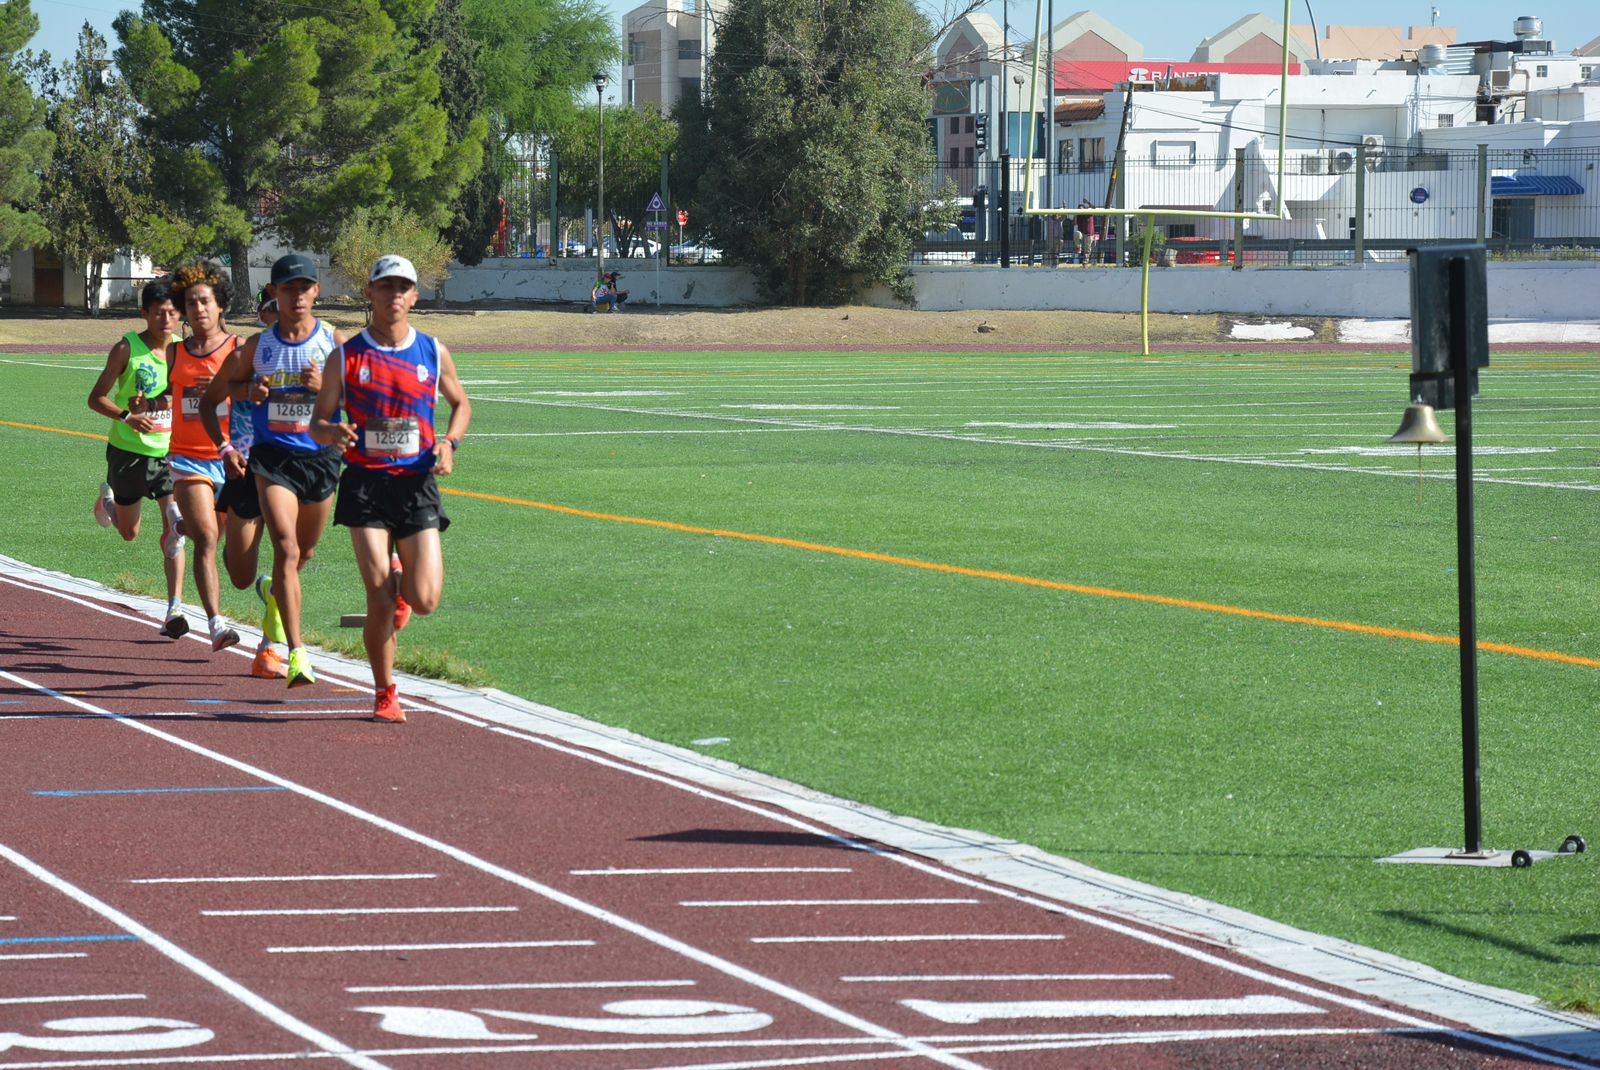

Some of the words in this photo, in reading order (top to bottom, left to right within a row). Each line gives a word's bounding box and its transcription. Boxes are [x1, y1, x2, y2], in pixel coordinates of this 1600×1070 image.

[1151, 71, 1229, 80] BANO
[276, 404, 311, 416] 12683
[375, 432, 409, 444] 12521
[898, 994, 1329, 1024] 1
[352, 998, 774, 1040] 2
